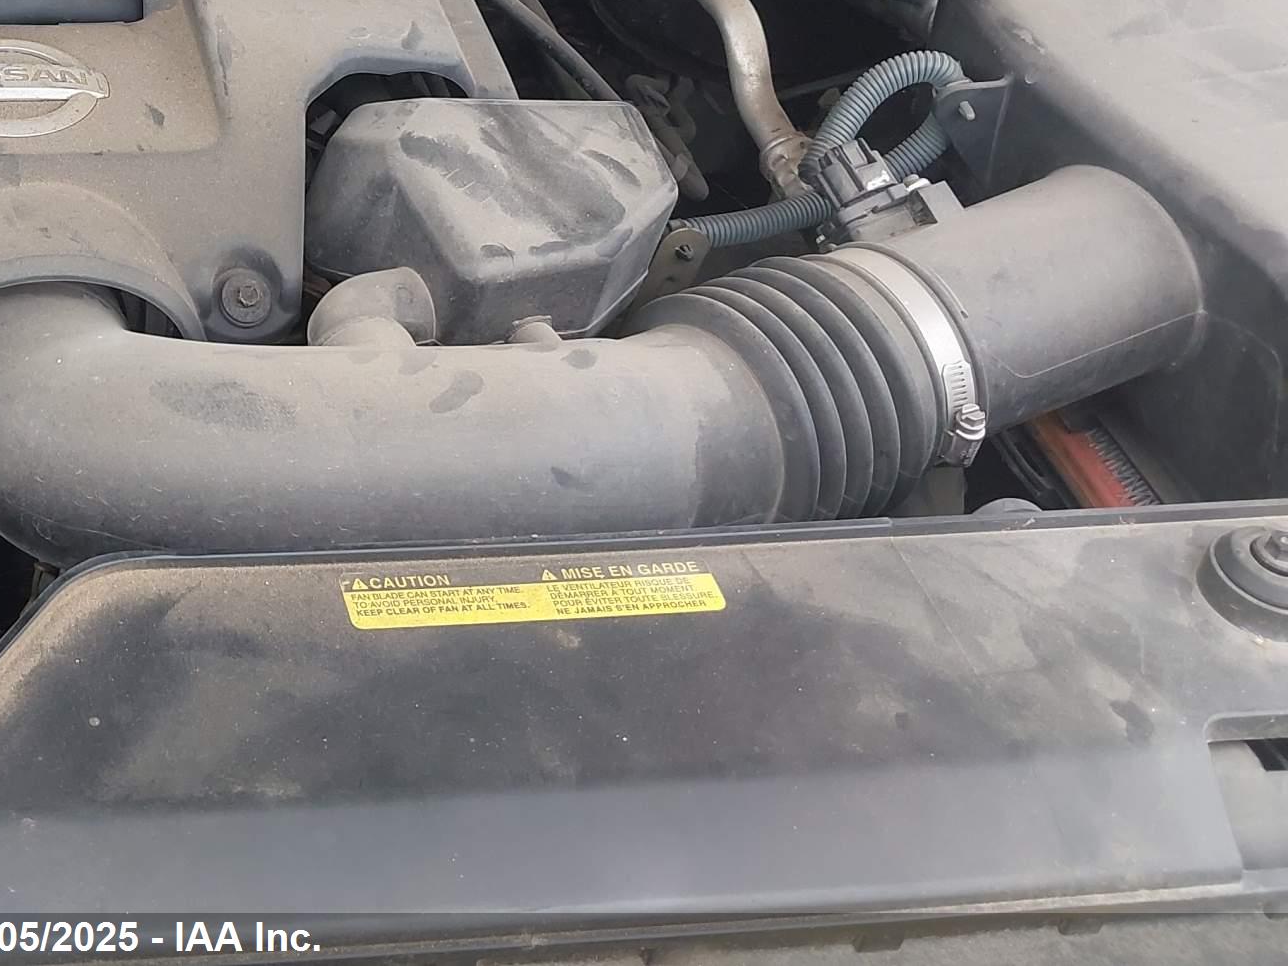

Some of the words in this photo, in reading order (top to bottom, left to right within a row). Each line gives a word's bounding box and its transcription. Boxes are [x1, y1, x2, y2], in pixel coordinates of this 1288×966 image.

[561, 566, 606, 580] MISE
[610, 565, 633, 577] EN
[637, 561, 700, 576] GARDE
[369, 575, 451, 590] CAUTION
[546, 584, 560, 592] LE
[562, 581, 631, 592] VENTILATEUR
[634, 579, 675, 588] RISQUE
[677, 577, 691, 585] DE
[351, 592, 370, 601] FAN
[372, 592, 404, 601] BLADE
[407, 591, 428, 600] CAN
[430, 590, 460, 598] START
[478, 588, 495, 596] ANY
[622, 587, 647, 596] TOUT
[353, 601, 369, 609] TO
[370, 600, 401, 609] AVOID
[404, 597, 458, 607] PERSONAL
[553, 599, 583, 608] POUR
[625, 595, 658, 604] TOUTE
[557, 607, 571, 616] NE
[574, 605, 612, 615] JAMAIS
[616, 603, 640, 612] S'EN
[642, 600, 707, 611] APPROCHER
[356, 609, 383, 617] KEEP
[386, 607, 420, 616] CLEAR
[423, 606, 437, 614] OF
[439, 605, 459, 613] FAN
[461, 604, 474, 612] AT
[476, 603, 495, 611] ALL
